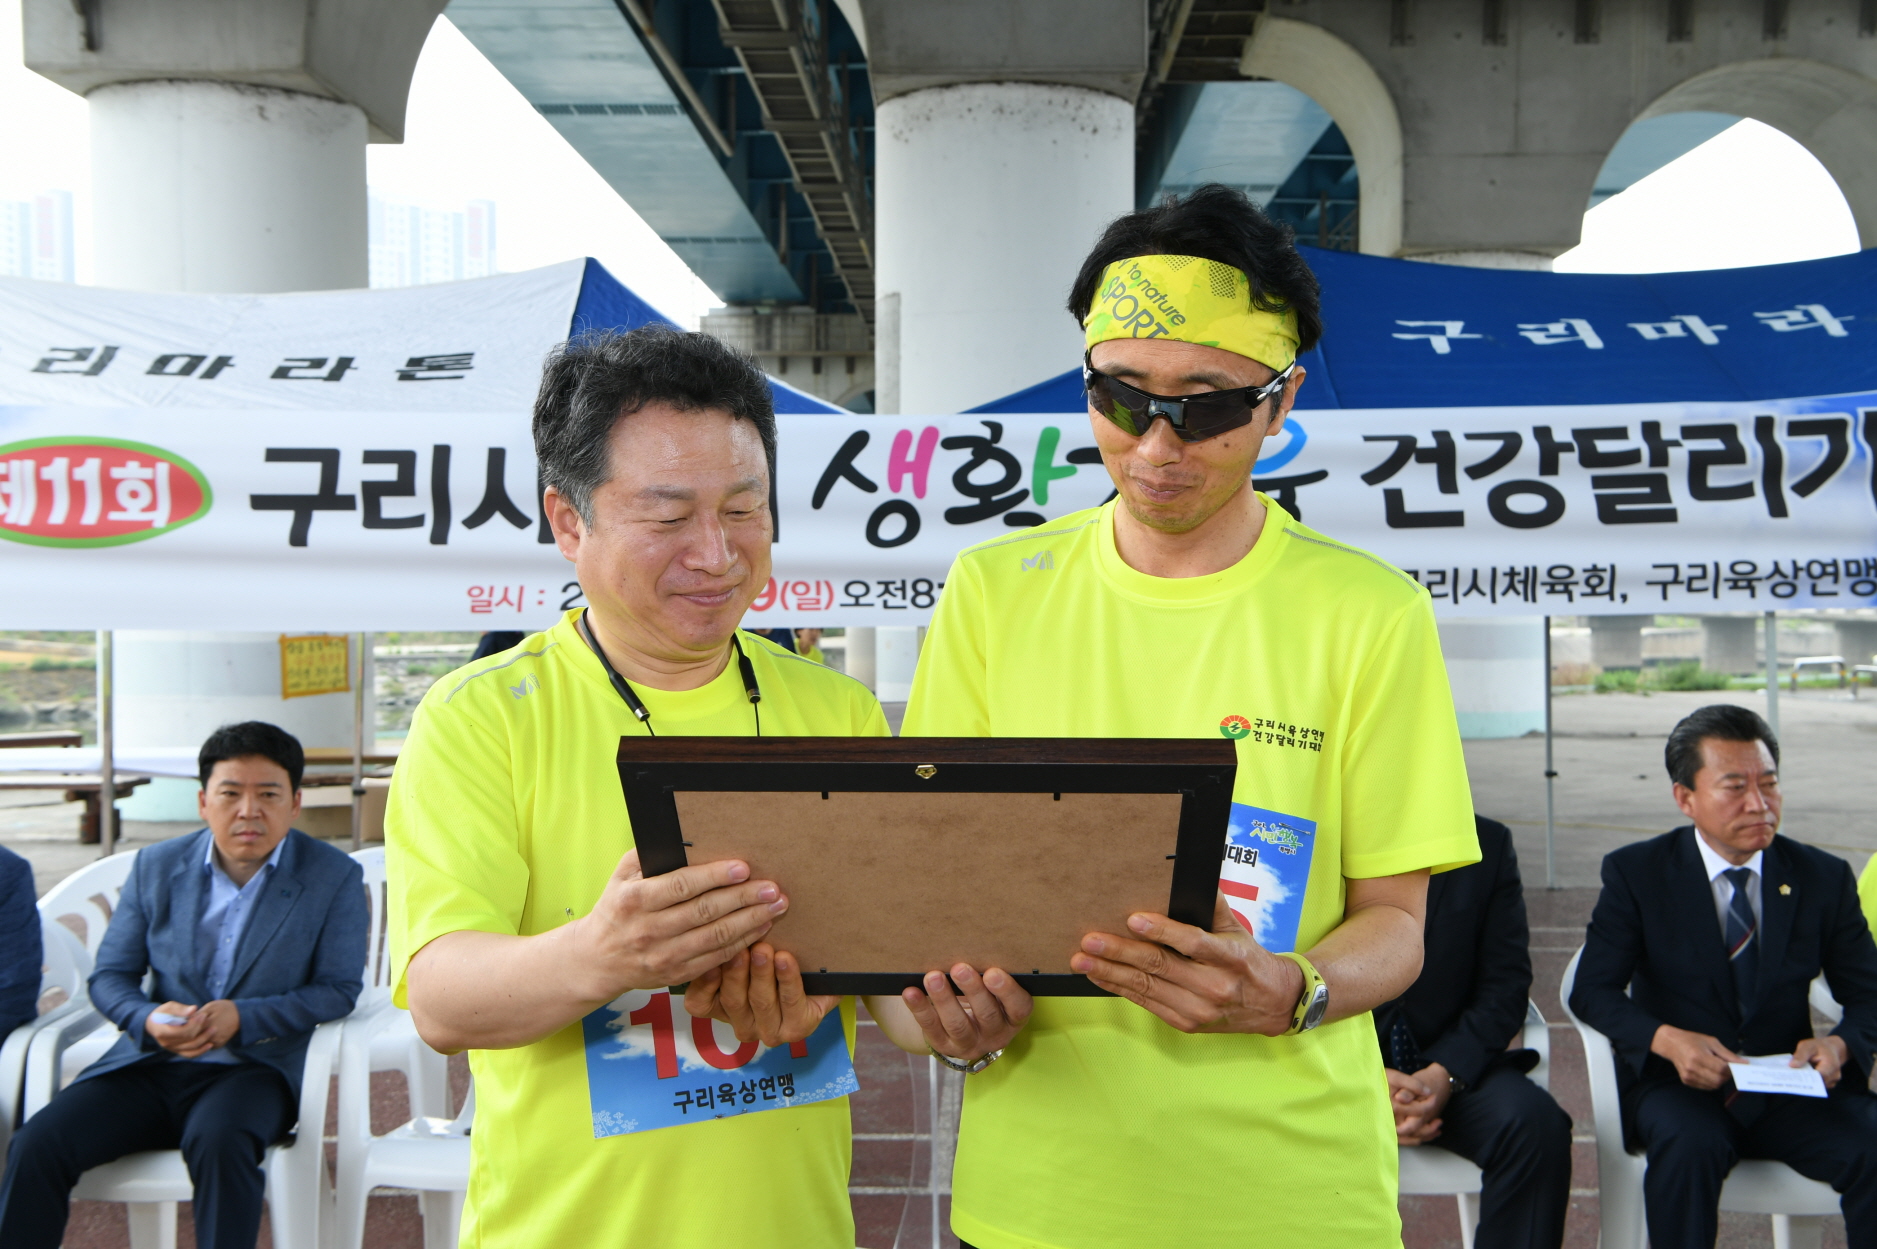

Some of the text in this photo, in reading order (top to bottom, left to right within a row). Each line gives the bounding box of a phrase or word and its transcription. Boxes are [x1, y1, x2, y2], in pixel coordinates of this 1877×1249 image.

[1101, 275, 1170, 339] SPORT
[1127, 262, 1142, 281] to
[1137, 278, 1186, 326] nature
[1361, 410, 1877, 529] 건강달리기
[839, 578, 946, 609] 오전8
[1404, 563, 1628, 604] 리시체육회,
[1646, 557, 1877, 604] 구리육상연맹
[1222, 844, 1258, 867] 대회
[630, 992, 808, 1080] 10
[673, 1073, 796, 1115] 구리육상연맹
